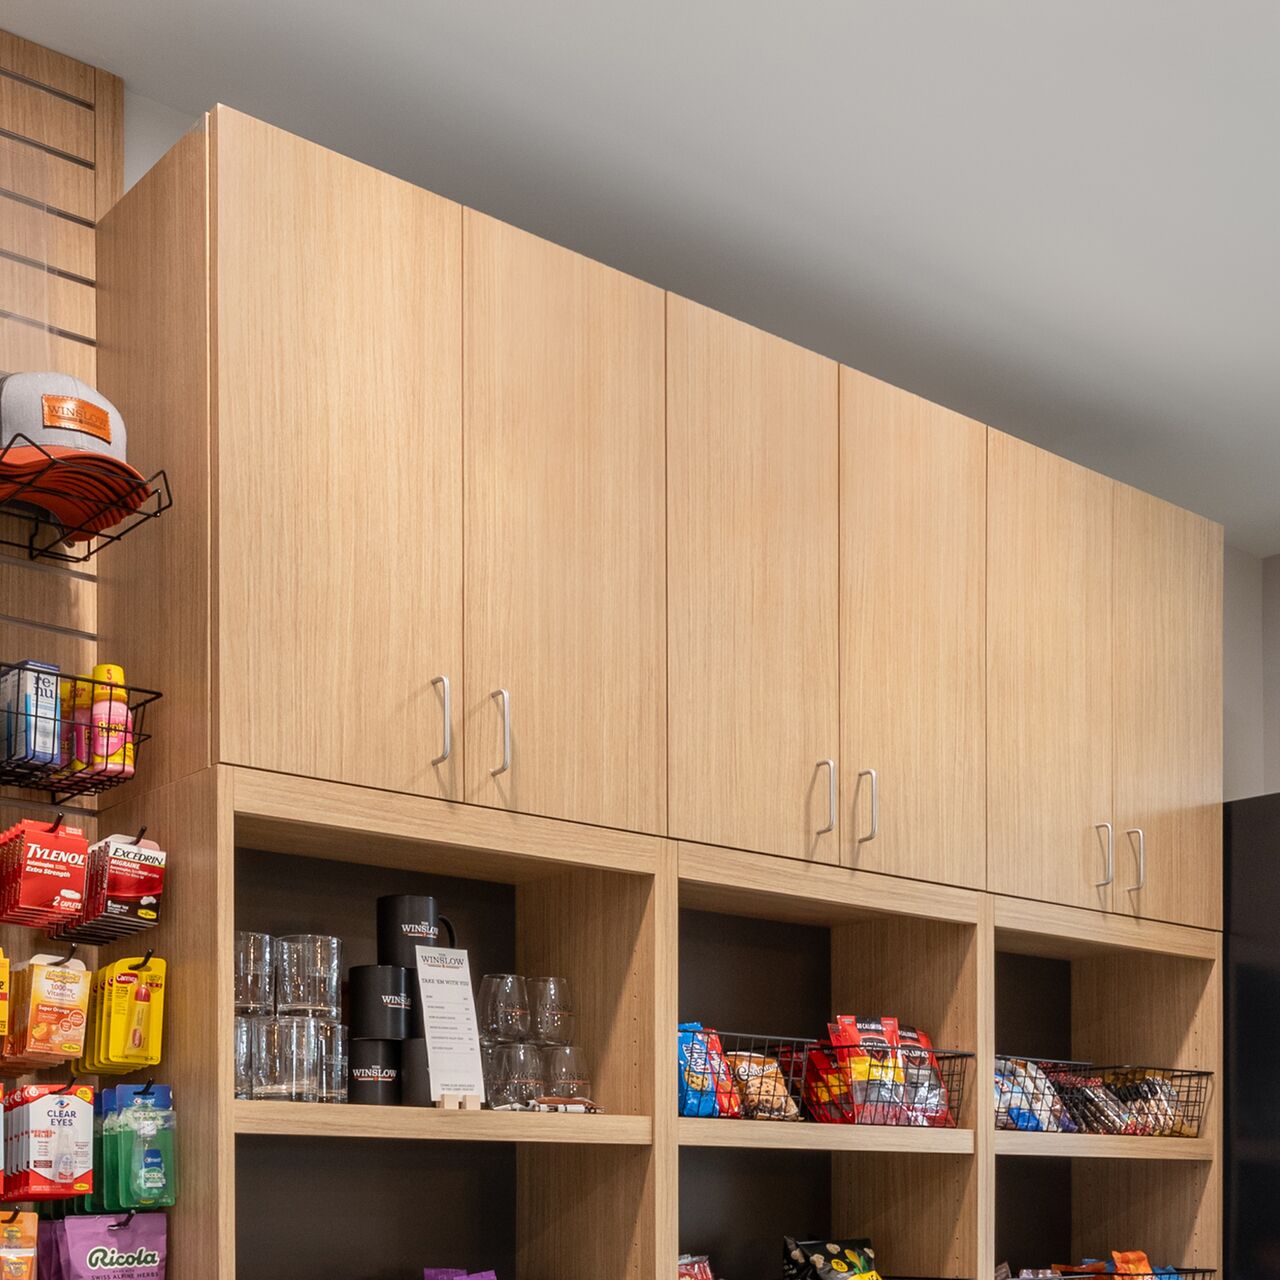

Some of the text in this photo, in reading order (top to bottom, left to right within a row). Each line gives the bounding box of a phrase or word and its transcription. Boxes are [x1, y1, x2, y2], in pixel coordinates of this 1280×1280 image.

[27, 843, 86, 866] TYLENOL
[113, 847, 164, 865] EXCEDRIN
[26, 866, 71, 878] Extra Strength
[53, 896, 83, 910] 2 CAPLETS
[420, 955, 465, 966] WINSLOW
[47, 989, 70, 997] Vitamin
[39, 1004, 70, 1015] Super Orange
[353, 1067, 397, 1079] WINSLOW
[47, 1110, 77, 1119] CLEAR
[50, 1118, 74, 1127] EYES
[88, 1247, 159, 1268] Ricola
